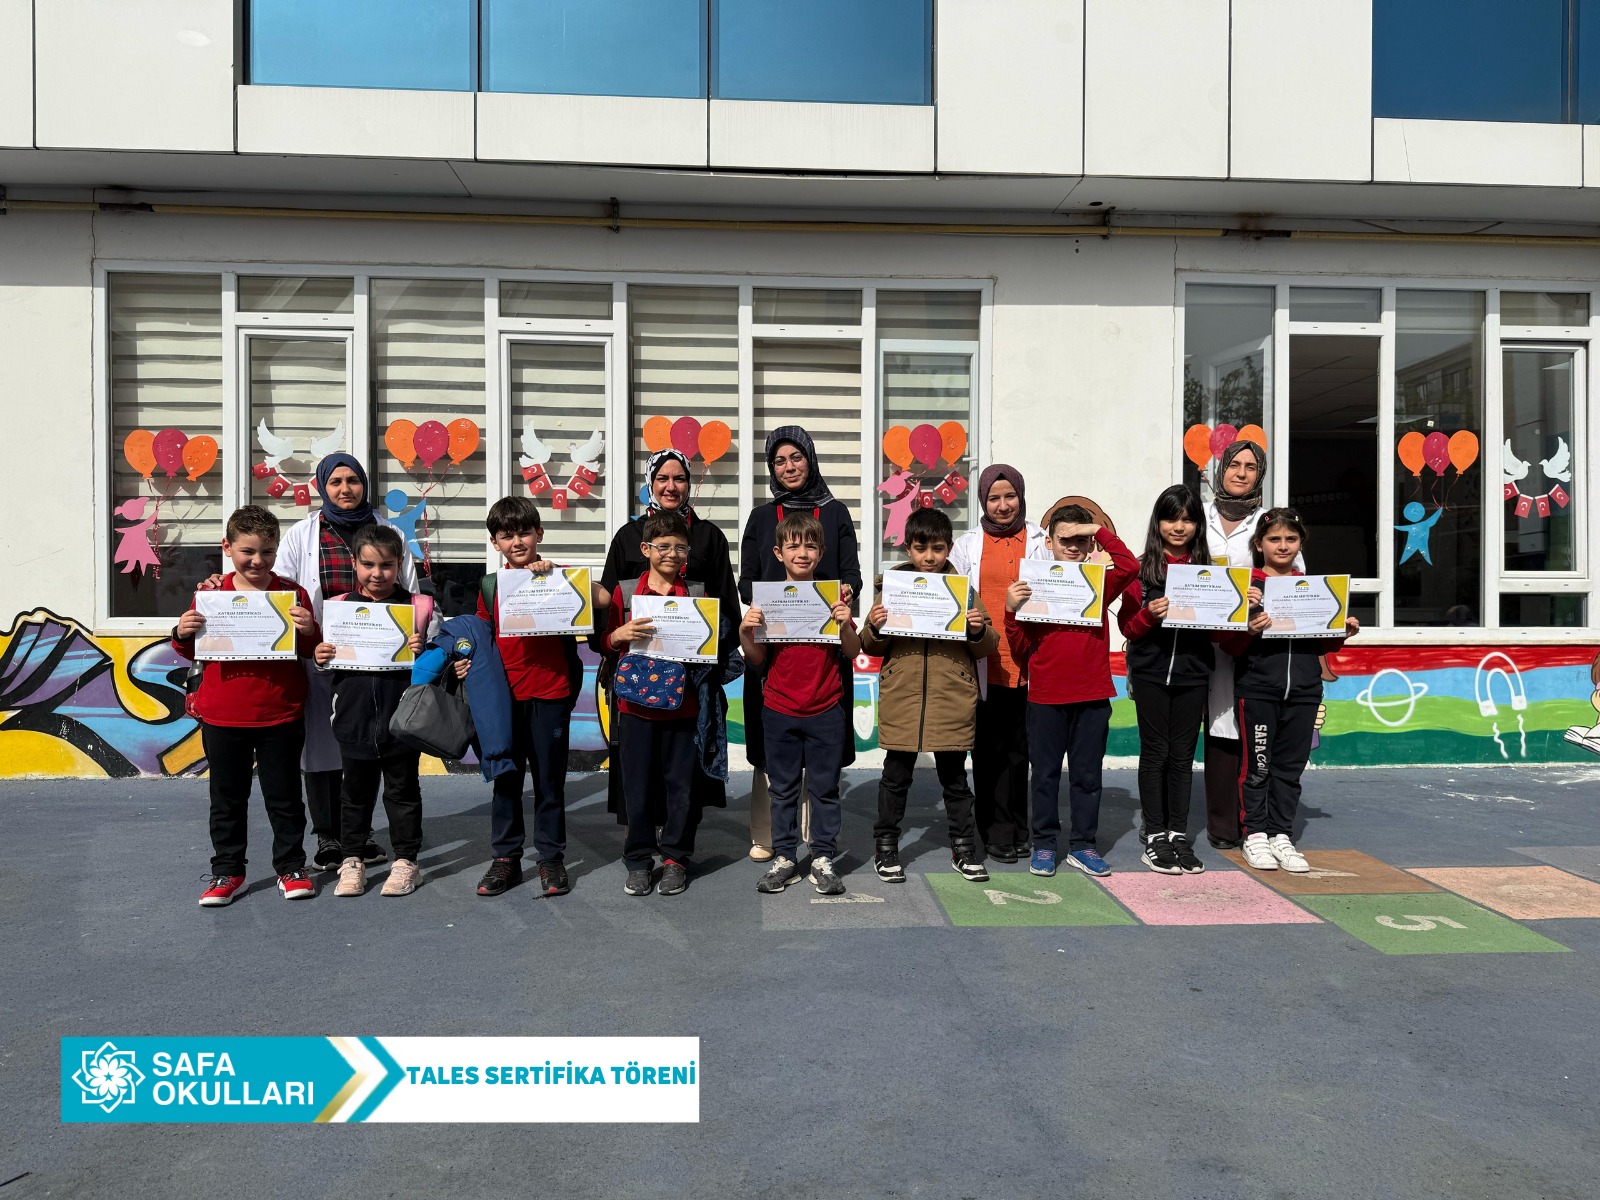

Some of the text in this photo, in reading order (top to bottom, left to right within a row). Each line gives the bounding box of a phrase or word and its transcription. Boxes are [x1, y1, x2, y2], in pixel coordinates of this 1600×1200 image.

[1254, 724, 1268, 753] SAFA
[983, 889, 1063, 905] 2
[1374, 914, 1469, 932] 5
